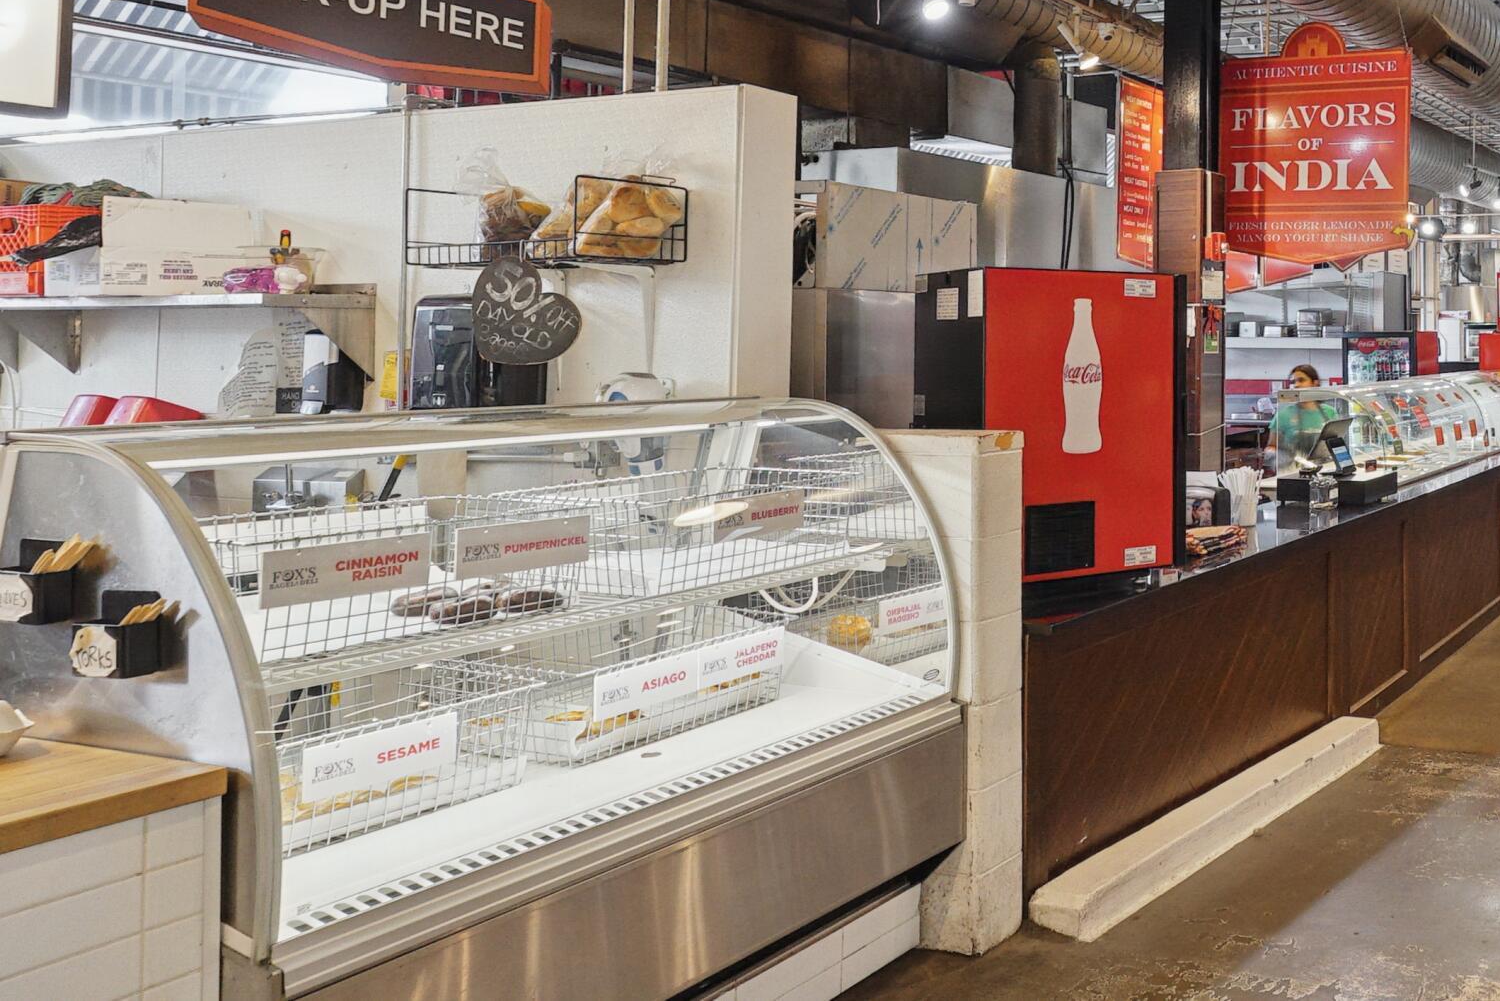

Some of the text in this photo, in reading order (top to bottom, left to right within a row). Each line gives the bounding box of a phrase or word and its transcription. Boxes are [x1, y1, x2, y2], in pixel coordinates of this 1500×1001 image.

[1232, 60, 1398, 80] AUTHENTIC CUISINE
[1231, 102, 1396, 132] FLAVORS
[1298, 137, 1323, 151] OF
[1230, 158, 1394, 193] INDIA
[1229, 220, 1393, 231] FRESH GINGER LEMONADE
[1236, 232, 1384, 243] MANGO YOGURT SHAKE
[546, 305, 578, 332] OFF
[751, 504, 800, 521] BLUEBERRY
[464, 543, 500, 558] FOX'S
[504, 536, 588, 555] PUMPERNICKEL
[335, 551, 419, 573] CINNAMON
[272, 566, 317, 584] FOX'S
[352, 565, 403, 583] RAISIN
[733, 639, 779, 660] JALAPENO
[736, 650, 777, 668] CHEDDAR
[641, 670, 687, 692] ASIAGO
[377, 737, 441, 765] SESAME
[313, 757, 354, 778] FOX'S
